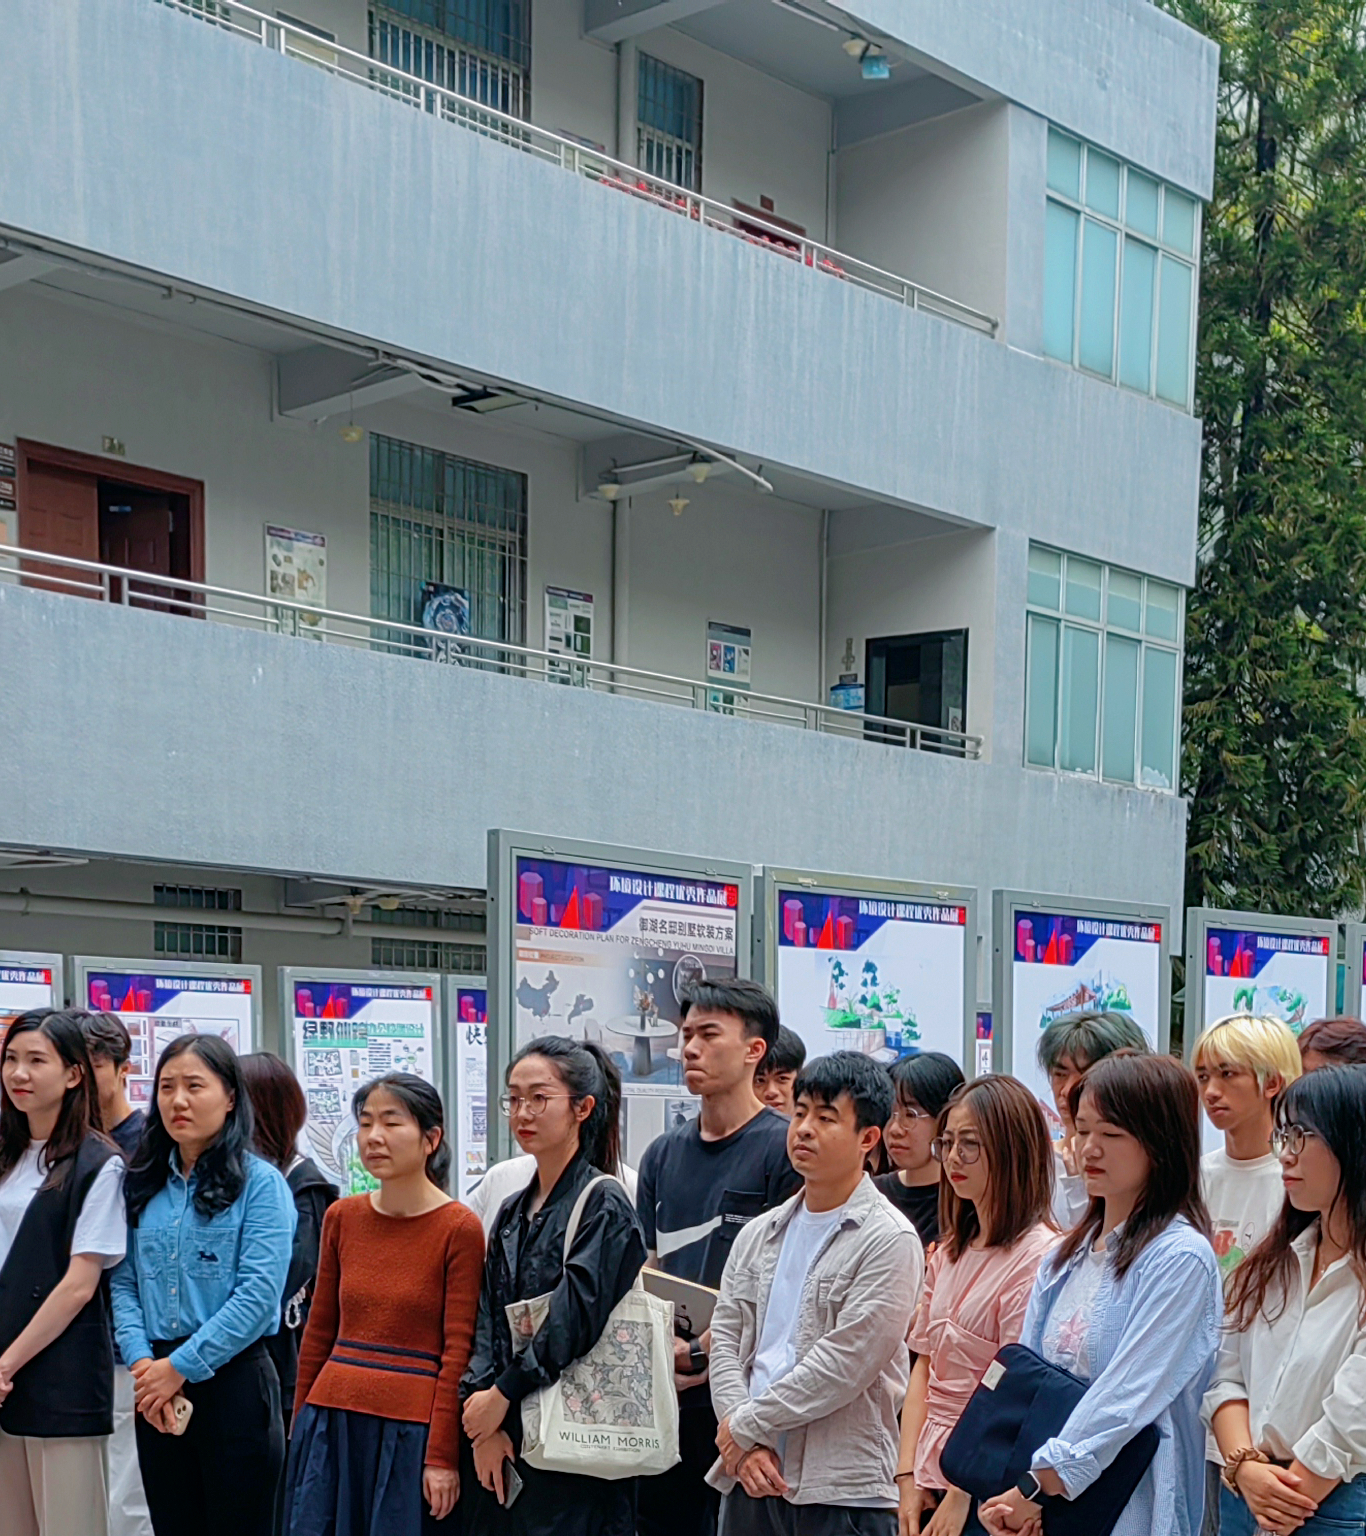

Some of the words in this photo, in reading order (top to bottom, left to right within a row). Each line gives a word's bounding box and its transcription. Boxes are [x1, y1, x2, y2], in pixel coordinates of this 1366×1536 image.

[609, 875, 728, 907] 环境设计课程优秀作品展
[859, 900, 959, 923] 环境设计课程优秀作品展
[639, 917, 734, 941] 御湖名邸别墅软装方案
[1076, 919, 1155, 940] 环境设计课程优秀作品展
[529, 927, 548, 937] SOFT
[550, 929, 595, 941] DECORATION
[597, 934, 615, 943] PLAN
[616, 935, 630, 944] FOR
[631, 936, 672, 949] ZENGCHENG
[673, 941, 692, 951] YUHU
[692, 943, 716, 953] MINGDI
[717, 945, 734, 955] VILLA
[155, 978, 245, 993] 环境设计课程优秀作品展
[351, 987, 427, 999] 环境设计课程优秀作品展
[466, 1025, 487, 1045] 快
[559, 1431, 611, 1445] WILLIAM
[618, 1436, 660, 1449] MORRIS
